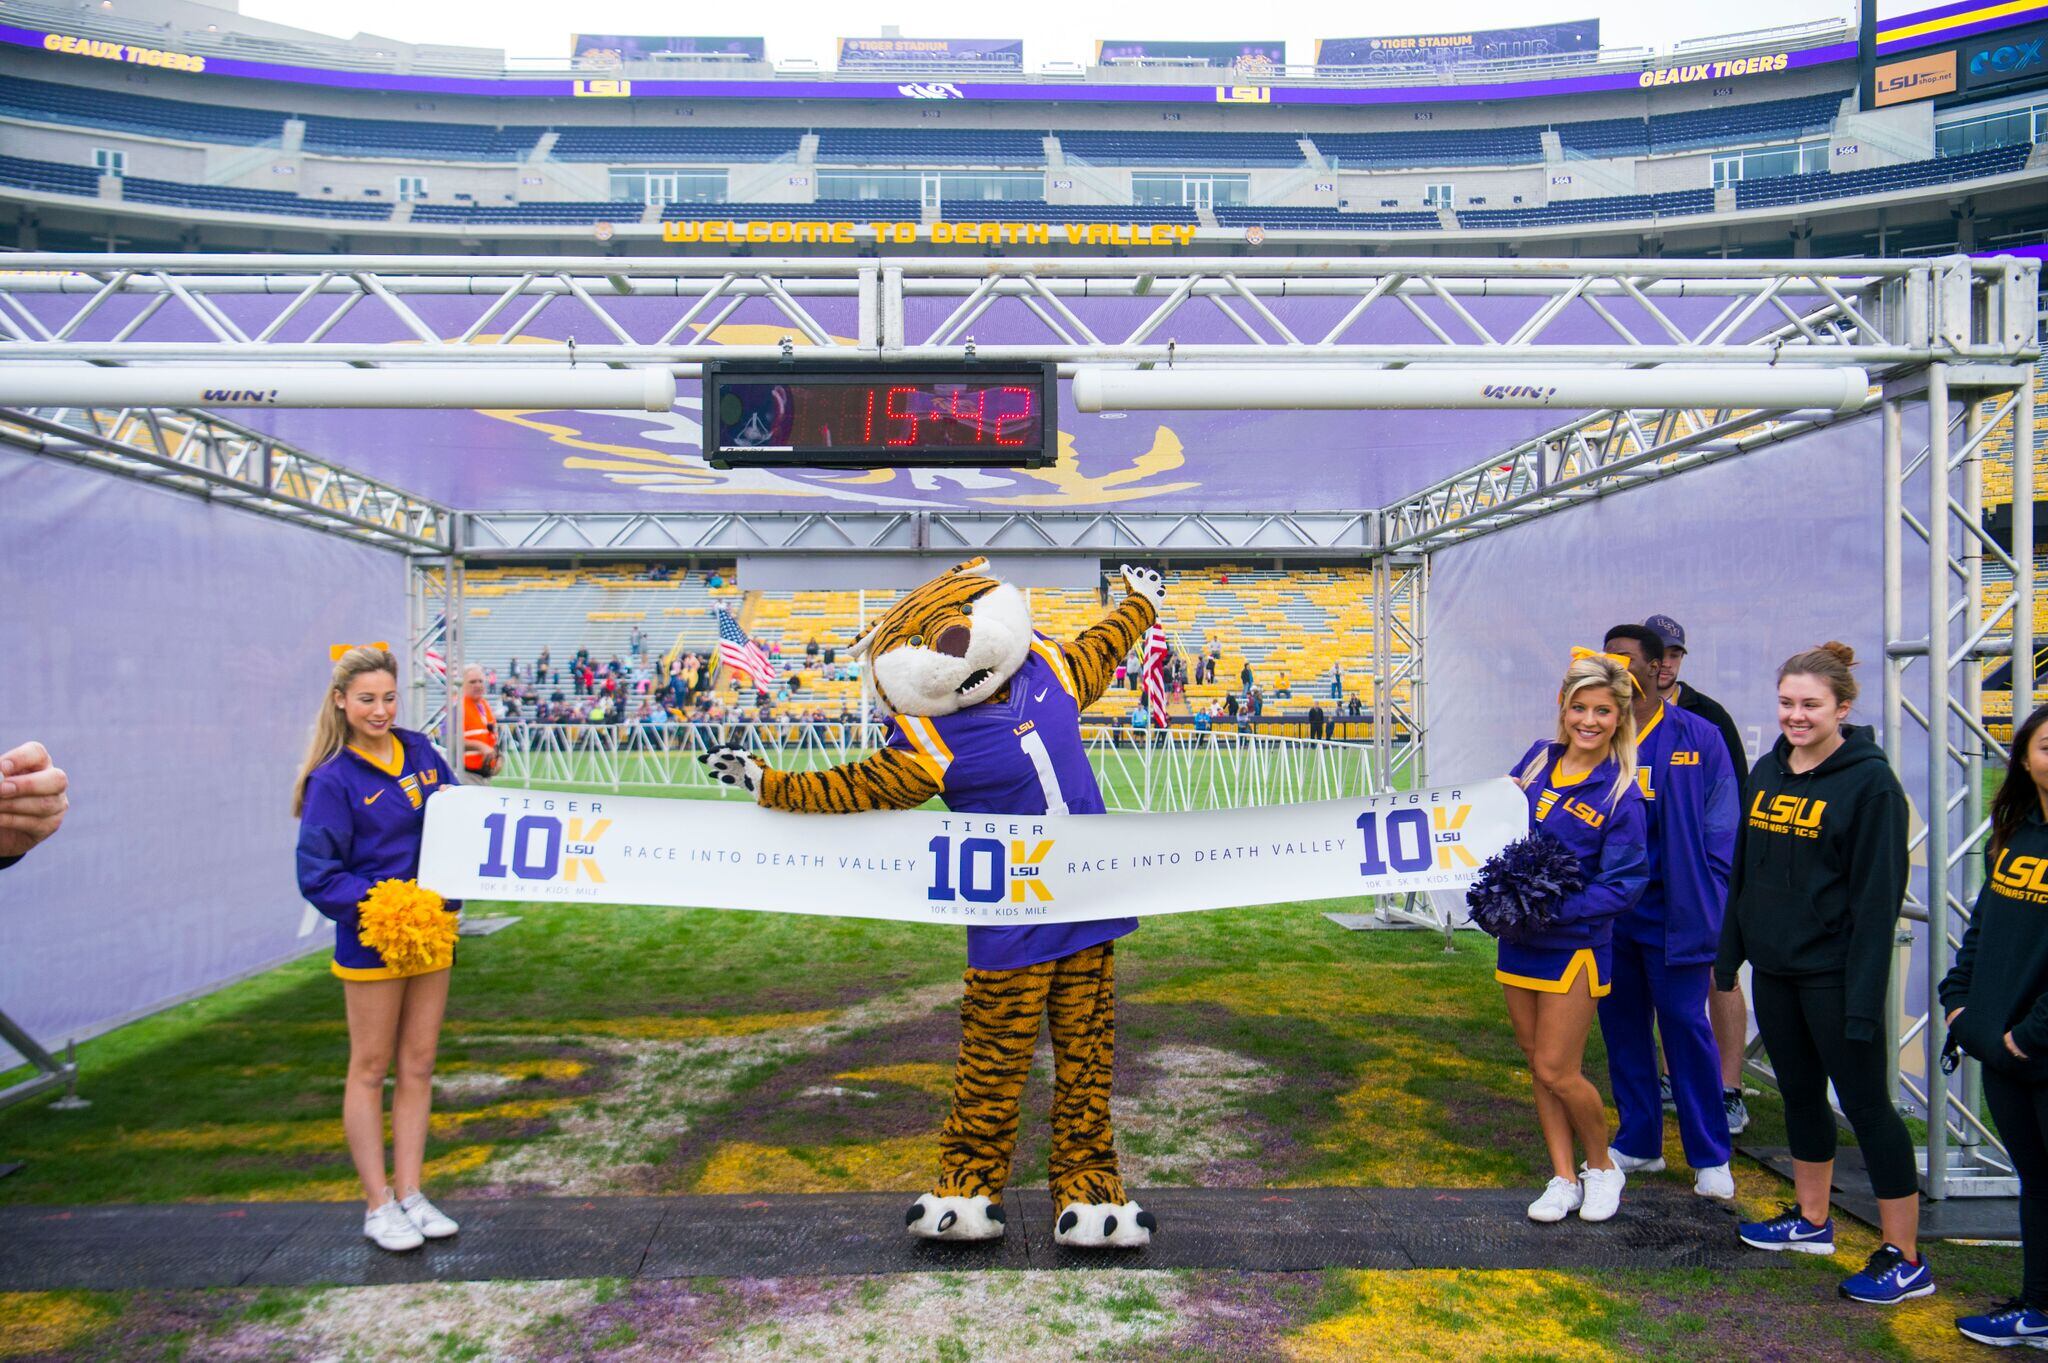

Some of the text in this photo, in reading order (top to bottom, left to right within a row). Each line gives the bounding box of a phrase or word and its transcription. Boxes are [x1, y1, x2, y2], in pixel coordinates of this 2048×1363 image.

[859, 41, 948, 51] TIGER STADIUM
[1381, 34, 1473, 49] TIGER STADIUM
[44, 33, 206, 73] GEAUX TIGERS
[1639, 53, 1788, 87] GEAUX TIGERS
[573, 80, 631, 97] LSU
[1877, 72, 1952, 93] LSU shop.net
[1216, 86, 1270, 102] LSU
[1839, 145, 1856, 155] 566
[663, 220, 1197, 246] WELCOME TO DEATH VALLEY
[201, 389, 278, 403] WIN!
[1480, 384, 1557, 404] WIN!
[1012, 719, 1035, 736] LSU
[1020, 730, 1070, 816] 1
[500, 797, 602, 813] TIGER
[1369, 790, 1462, 807] TIGER
[1562, 796, 1605, 829] LSU
[1750, 790, 1827, 828] LSU
[941, 820, 1043, 835] TIGER
[1356, 804, 1480, 876] 10K
[1434, 832, 1461, 843] LSU
[478, 812, 614, 884] 10K
[565, 844, 594, 855] LSU
[1067, 839, 1346, 873] RACE INTO DEATH VALLEY
[623, 845, 917, 871] RACE INTO DEATH VALLEY
[927, 835, 1056, 904] 10K
[1010, 866, 1040, 877] LSU
[1427, 874, 1449, 884] KIDS
[930, 905, 1048, 916] 10K 5K KIDS MILE
